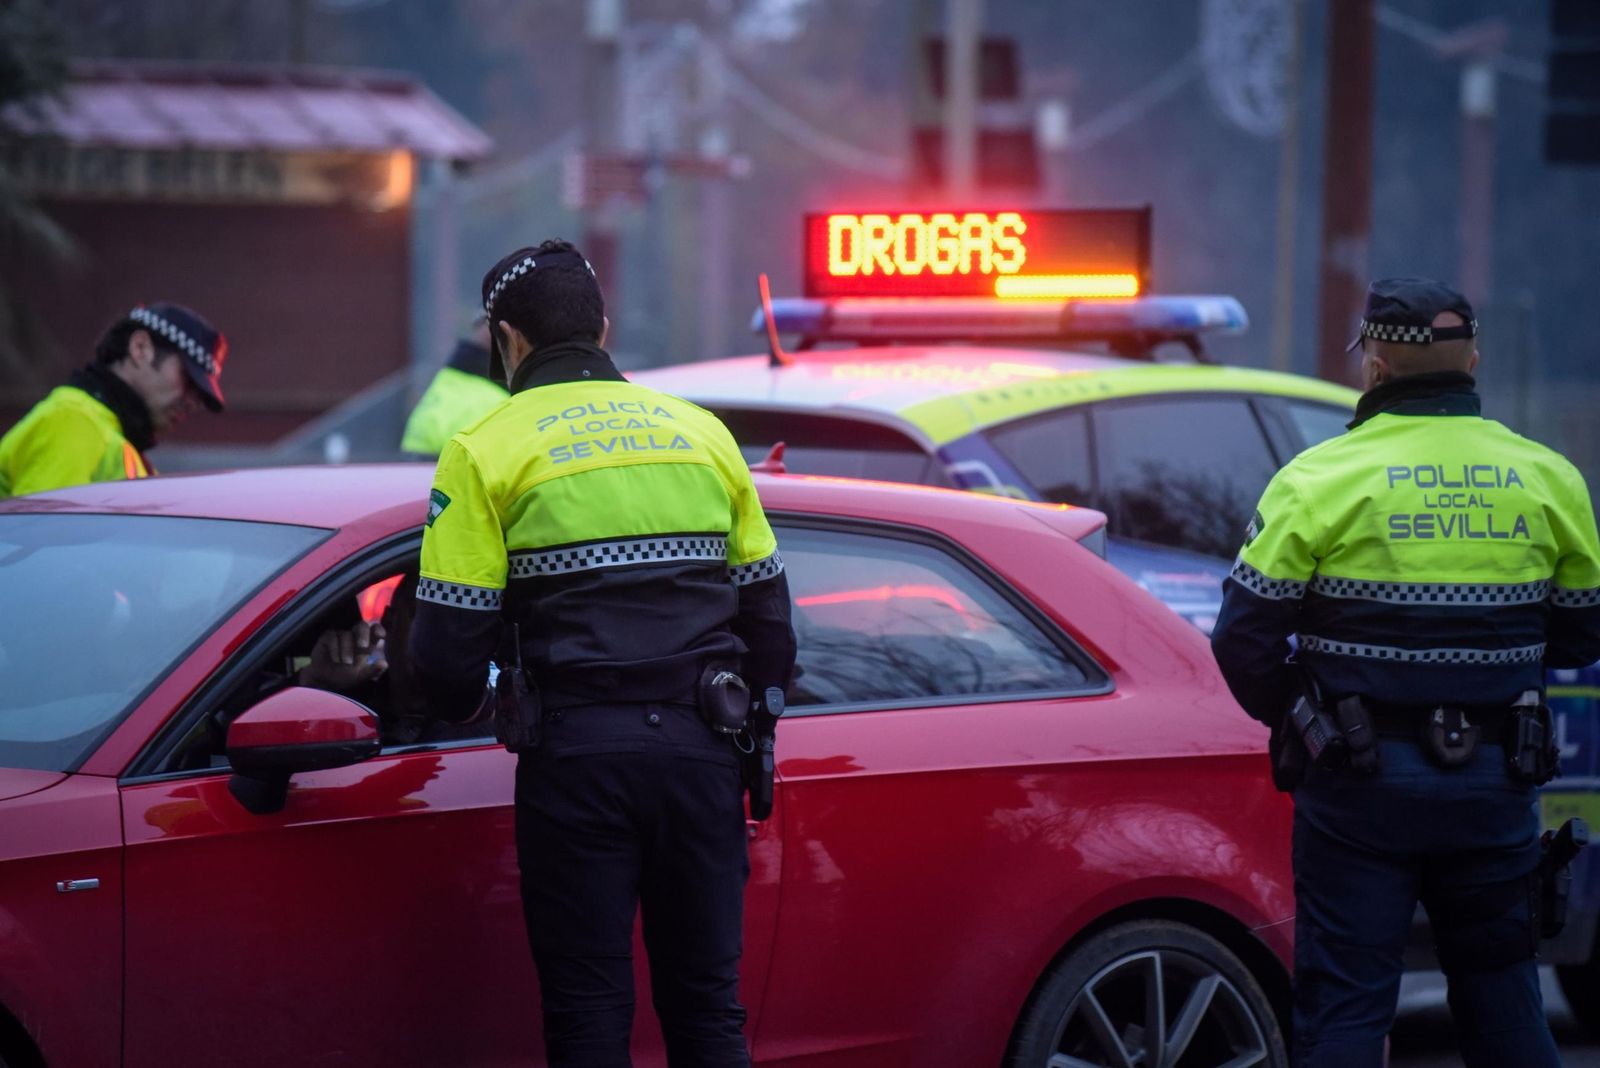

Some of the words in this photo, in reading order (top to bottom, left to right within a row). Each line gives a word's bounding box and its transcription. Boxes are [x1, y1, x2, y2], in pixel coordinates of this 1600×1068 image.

[828, 213, 1027, 276] DROGAS
[569, 418, 661, 436] LOCAL
[549, 434, 693, 464] SEVILLA
[1387, 464, 1524, 489] POLICIA
[1424, 493, 1494, 508] LOCAL
[1388, 513, 1530, 539] SEVILLA
